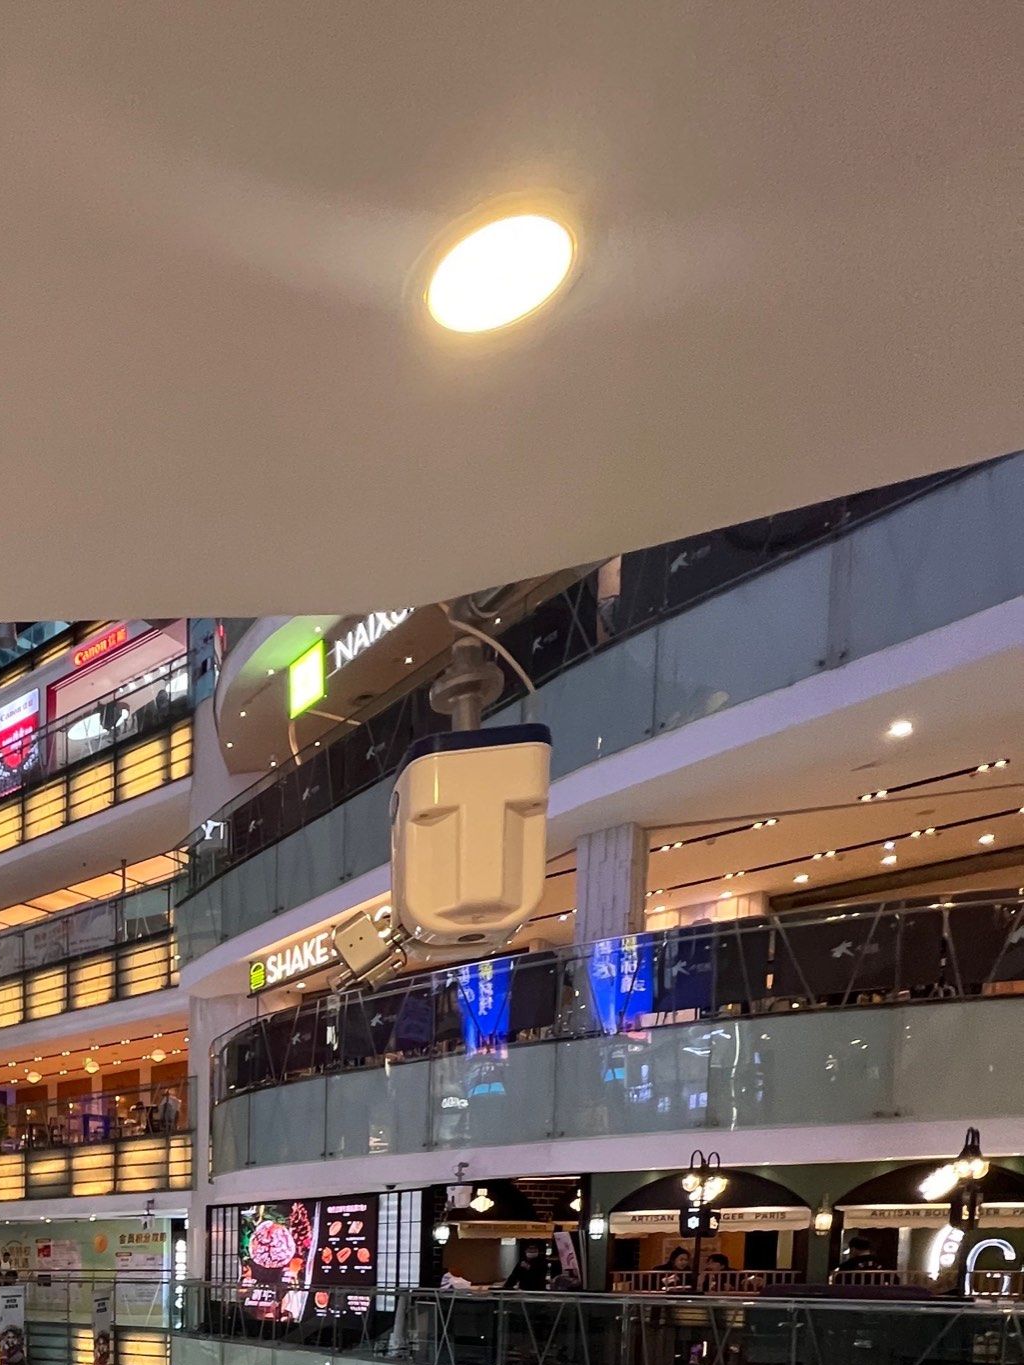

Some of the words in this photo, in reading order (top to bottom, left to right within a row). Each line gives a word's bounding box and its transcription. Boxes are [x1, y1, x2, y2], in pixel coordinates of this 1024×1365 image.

[266, 932, 329, 984] SHAKE
[755, 1211, 787, 1220] PARIS
[871, 1209, 921, 1218] ARTISAN
[630, 1214, 675, 1223] ARTISAN
